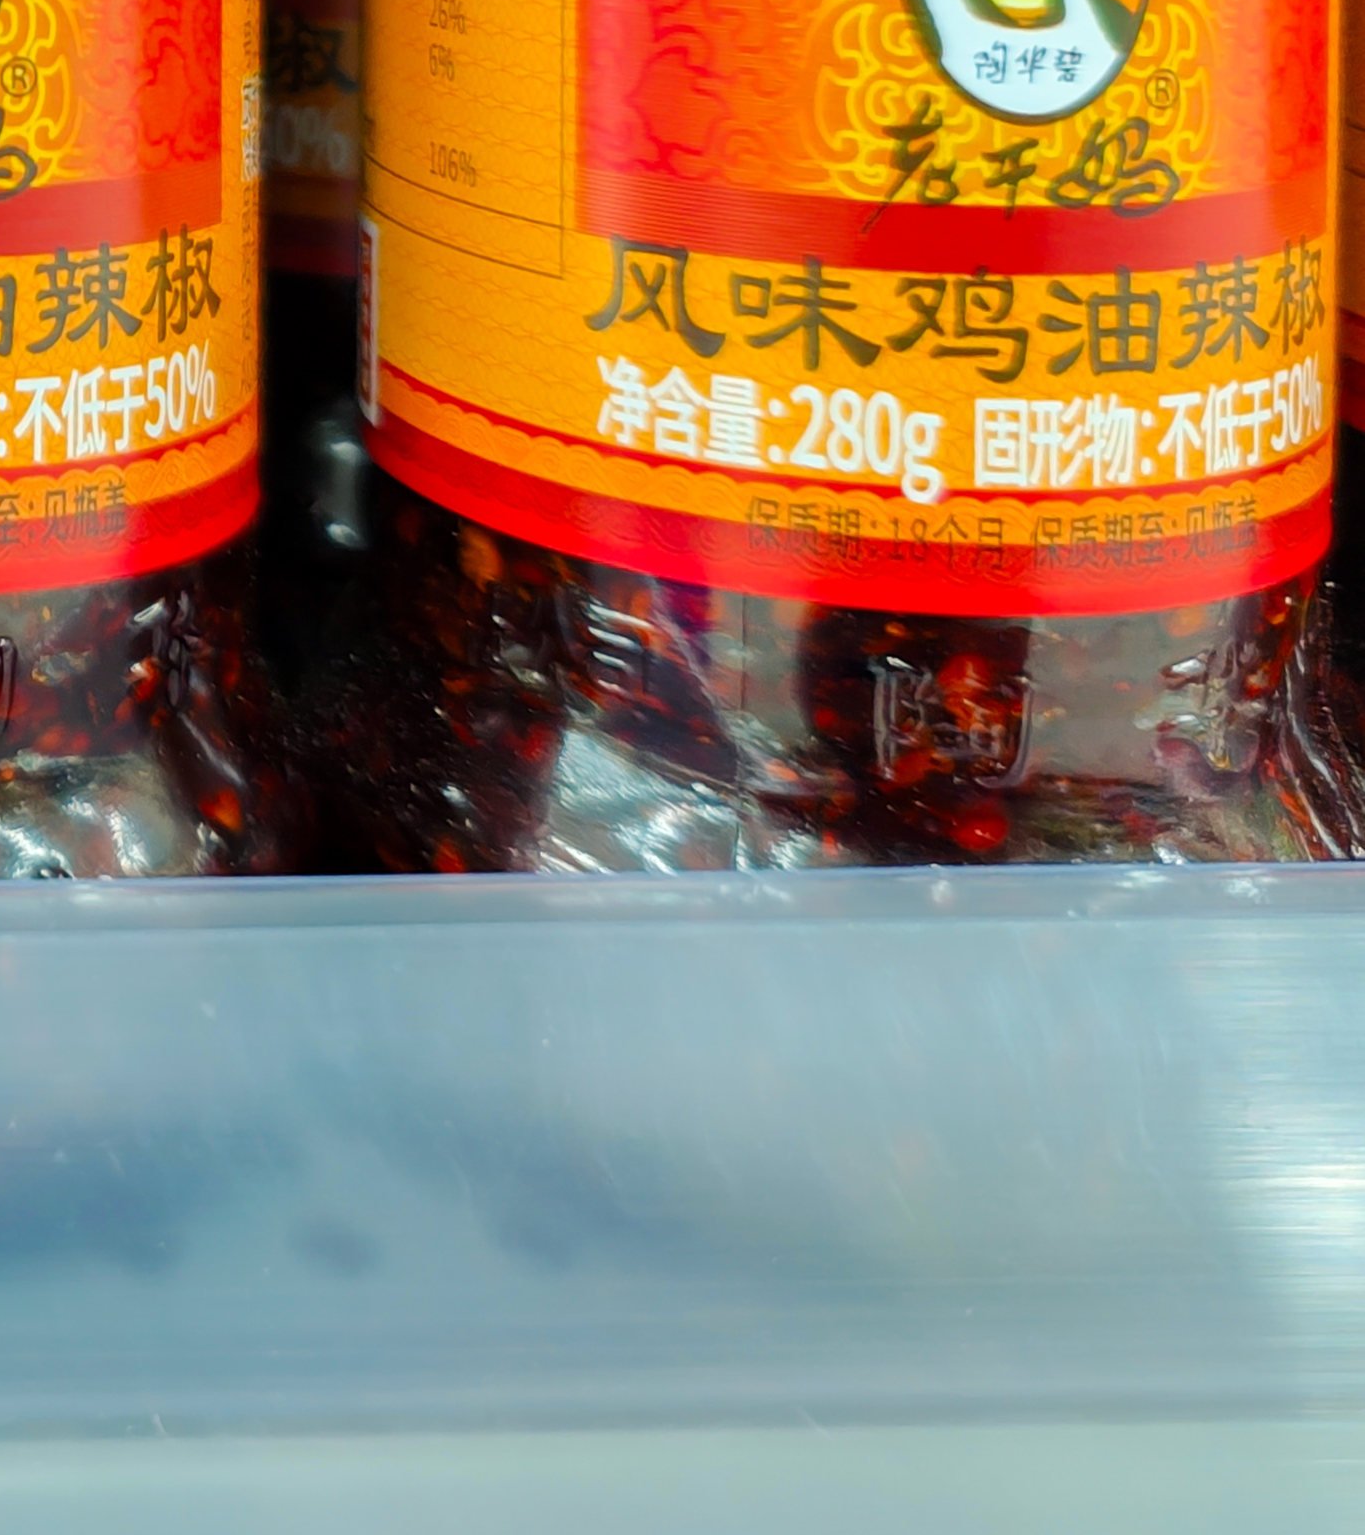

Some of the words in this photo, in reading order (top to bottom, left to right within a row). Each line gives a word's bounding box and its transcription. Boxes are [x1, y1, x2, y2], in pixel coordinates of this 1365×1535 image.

[429, 43, 455, 82] 6%
[430, 141, 477, 188] 106%
[583, 234, 1325, 384] 风味鸡油辣椒
